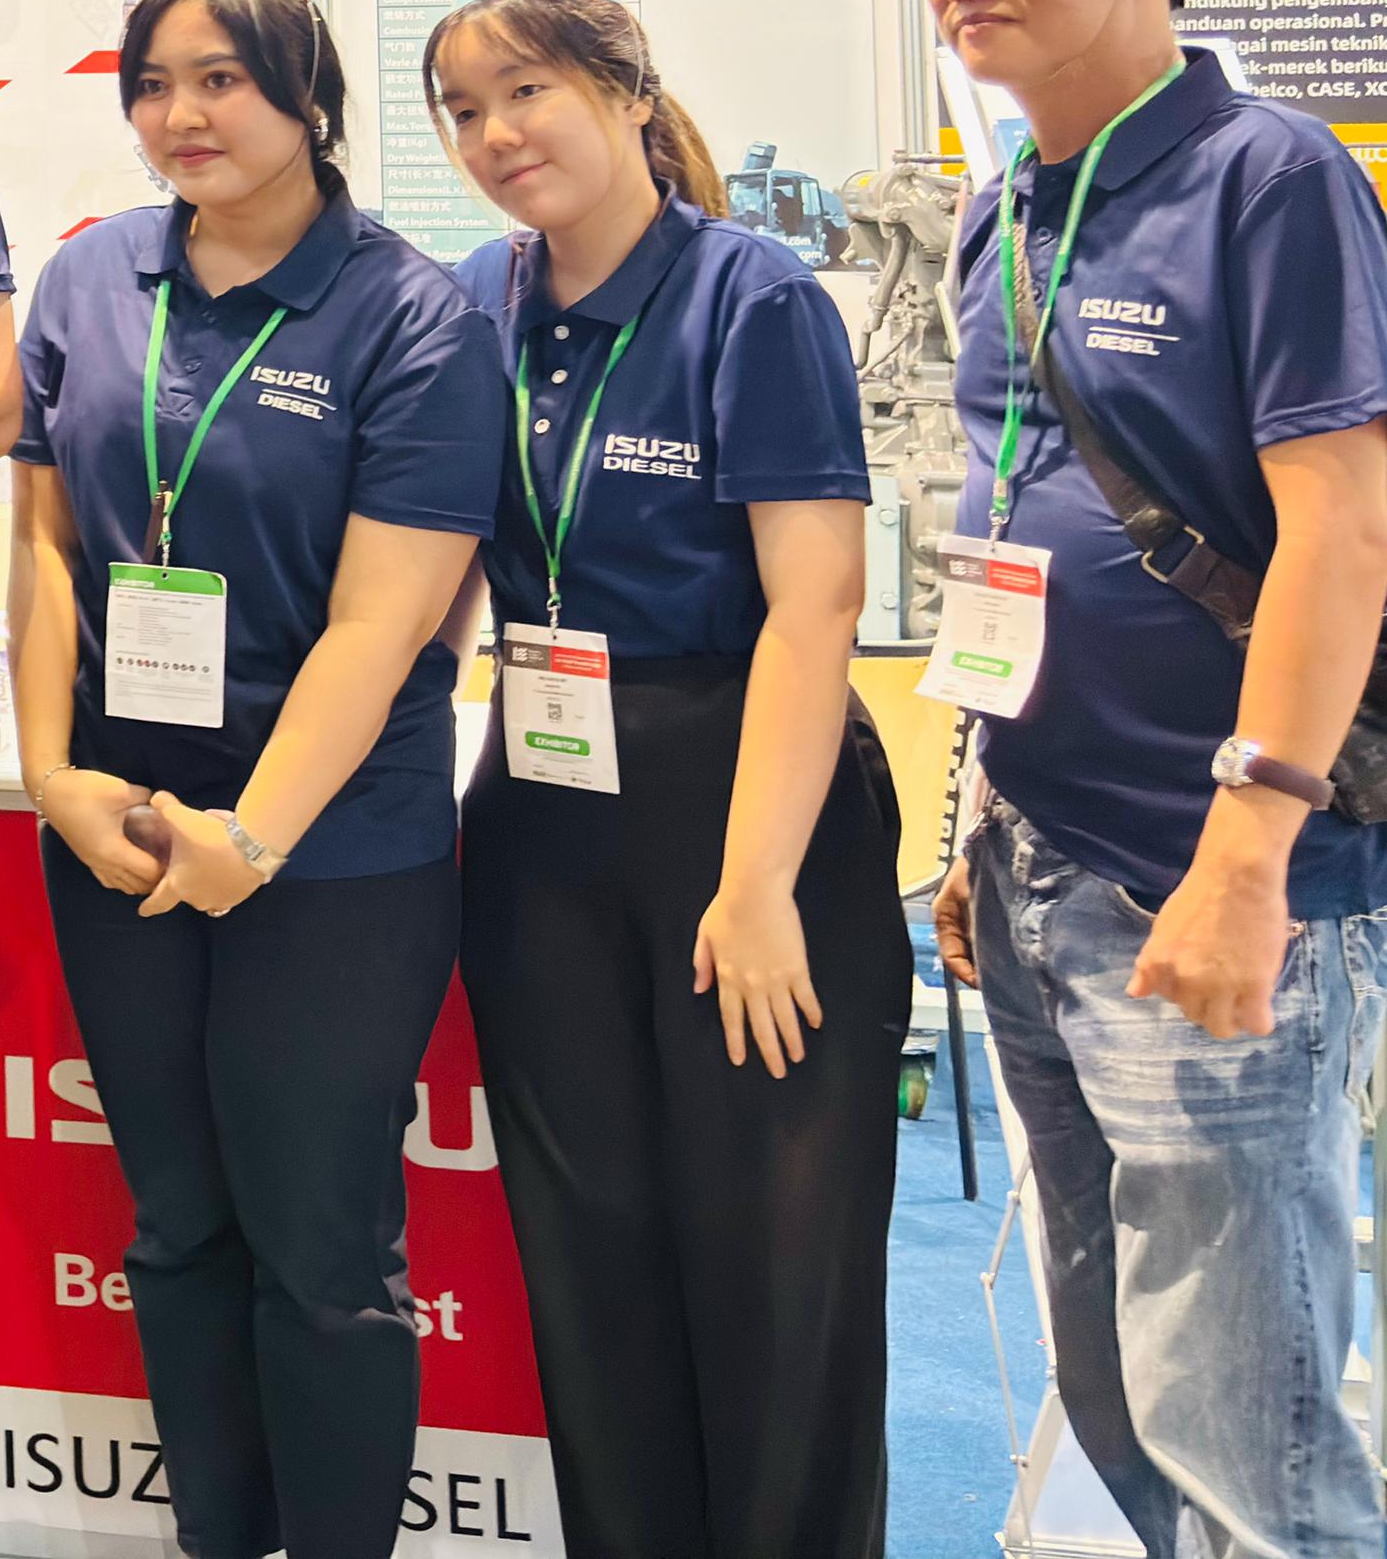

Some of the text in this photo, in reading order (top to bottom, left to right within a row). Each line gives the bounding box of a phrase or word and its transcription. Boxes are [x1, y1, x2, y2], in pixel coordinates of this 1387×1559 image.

[1249, 13, 1367, 36] operasional.
[1271, 36, 1328, 53] mesin
[1307, 81, 1361, 100] CASE,
[1078, 299, 1166, 327] ISUZU
[1085, 333, 1161, 356] DIESEL
[250, 366, 331, 395] ISUZU
[258, 393, 324, 420] DIESEL
[605, 434, 700, 463] ISUZU
[603, 457, 702, 480] DIESEL
[4, 1430, 172, 1506] ISUZ
[402, 1471, 531, 1542] SEL
